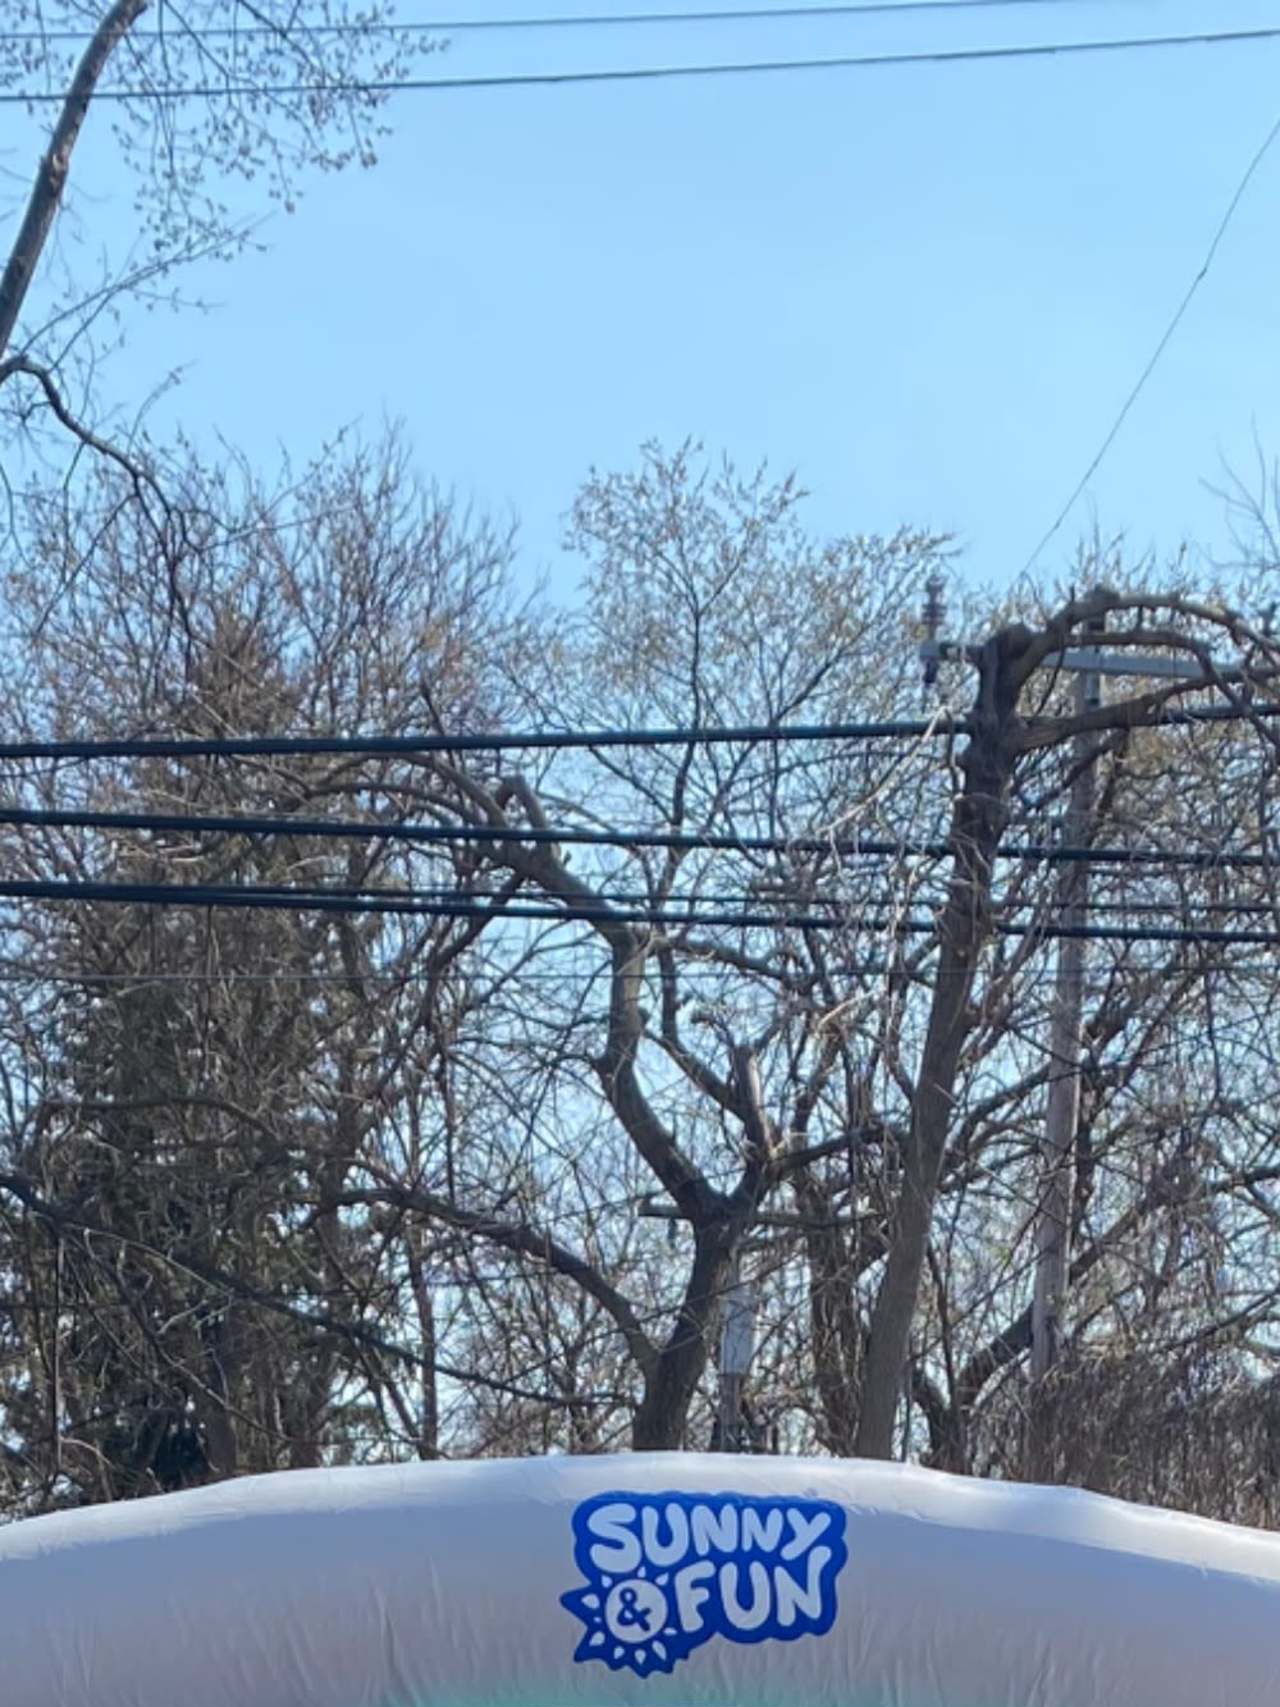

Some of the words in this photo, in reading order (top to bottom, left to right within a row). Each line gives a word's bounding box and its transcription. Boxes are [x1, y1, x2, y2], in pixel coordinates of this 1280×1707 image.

[586, 1502, 833, 1574] SUNNY
[616, 1586, 652, 1632] &
[674, 1545, 832, 1633] FUN
